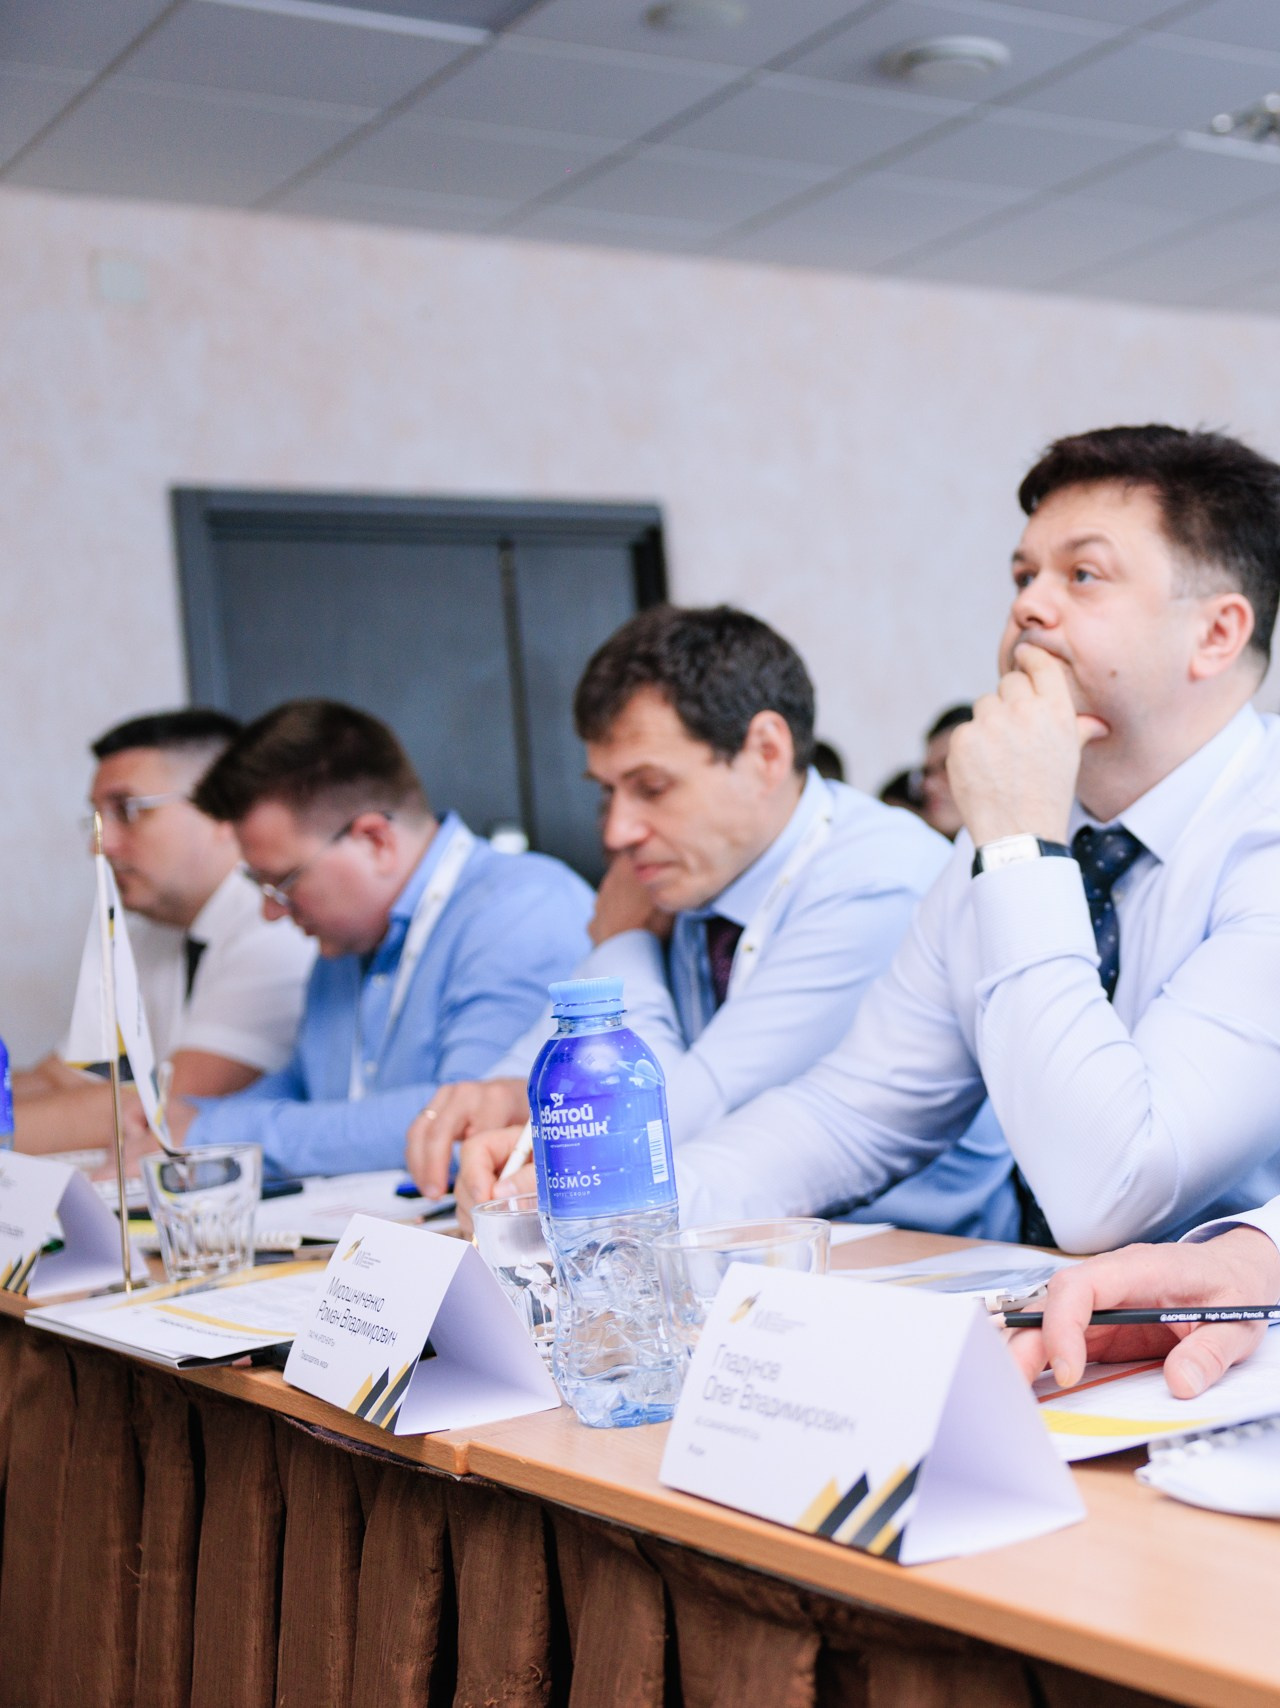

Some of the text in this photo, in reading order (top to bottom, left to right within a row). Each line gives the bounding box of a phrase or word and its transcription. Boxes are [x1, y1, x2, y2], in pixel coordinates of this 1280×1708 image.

[541, 1120, 609, 1140] сточник
[548, 1173, 601, 1189] COSMOS
[327, 1276, 385, 1312] Мирошниченко
[316, 1300, 342, 1325] Роман
[340, 1308, 398, 1346] Владимирович
[1205, 1312, 1220, 1321] High
[1220, 1311, 1243, 1320] Quality
[1243, 1310, 1264, 1319] Pencils
[702, 1375, 738, 1405] Олег
[739, 1383, 857, 1435] Владимирович
